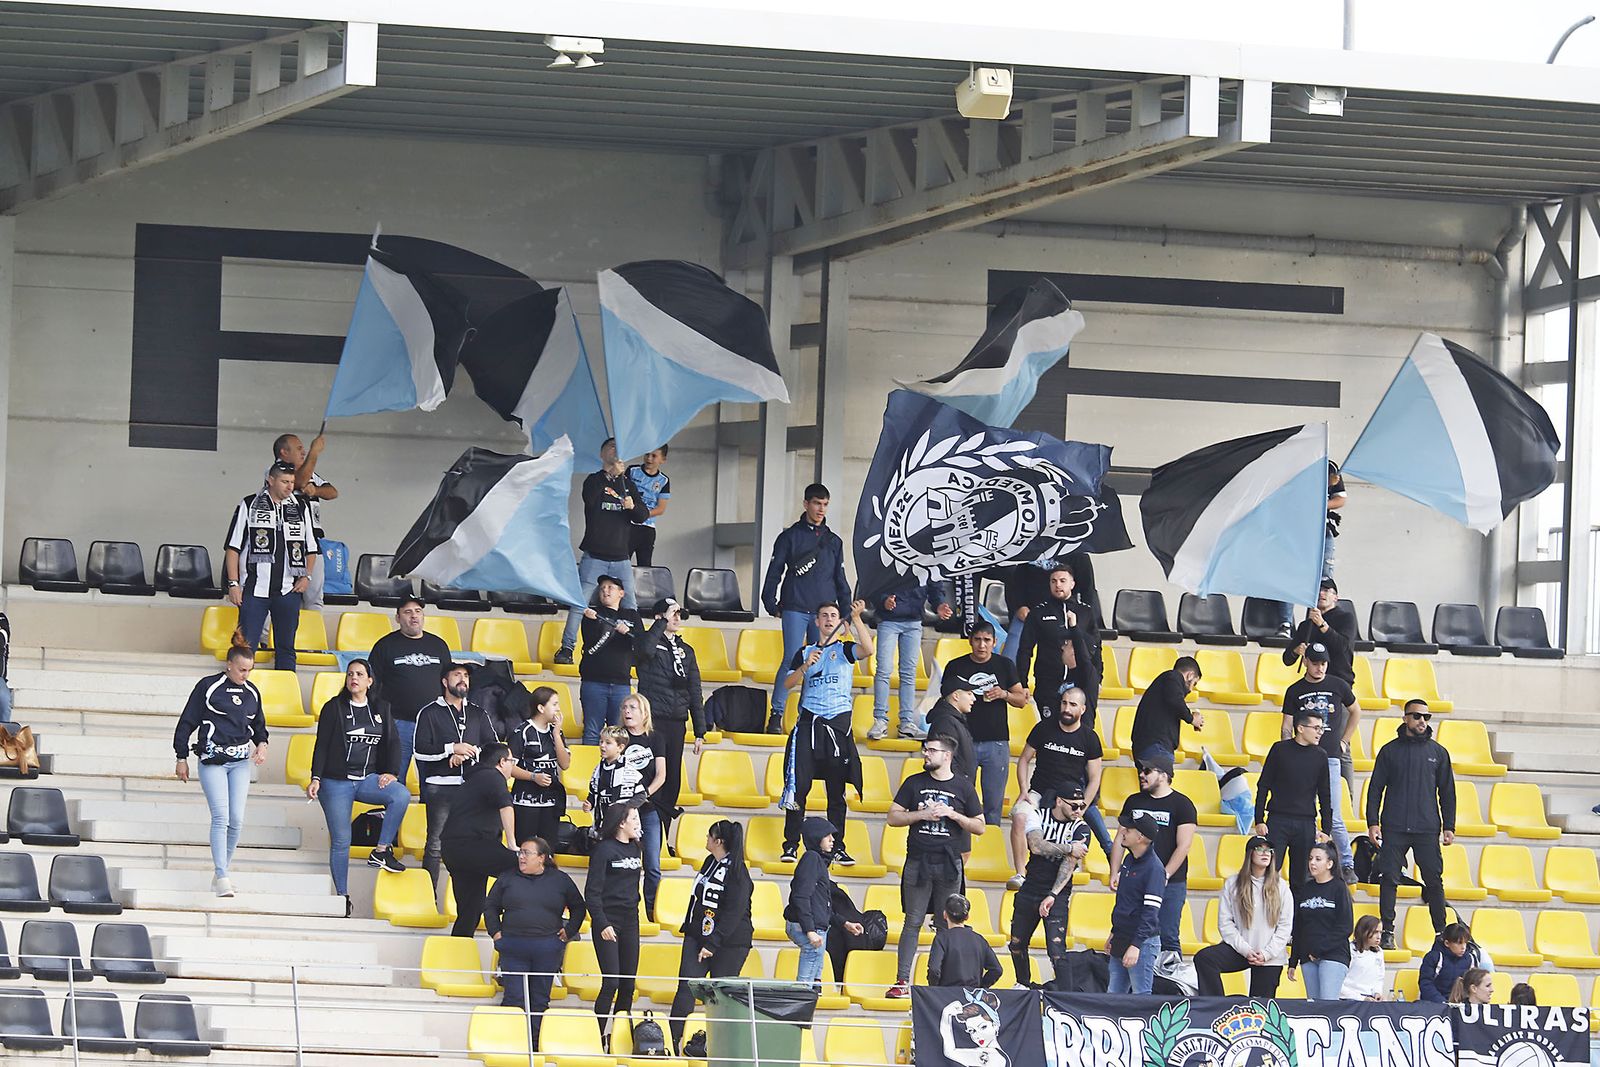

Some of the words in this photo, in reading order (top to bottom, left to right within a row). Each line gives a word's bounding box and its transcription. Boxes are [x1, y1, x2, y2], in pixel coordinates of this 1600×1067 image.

[347, 735, 381, 745] OTUS
[532, 759, 558, 769] LOTU
[1459, 1002, 1590, 1033] ULTRAS
[1487, 1031, 1524, 1057] AGAINST
